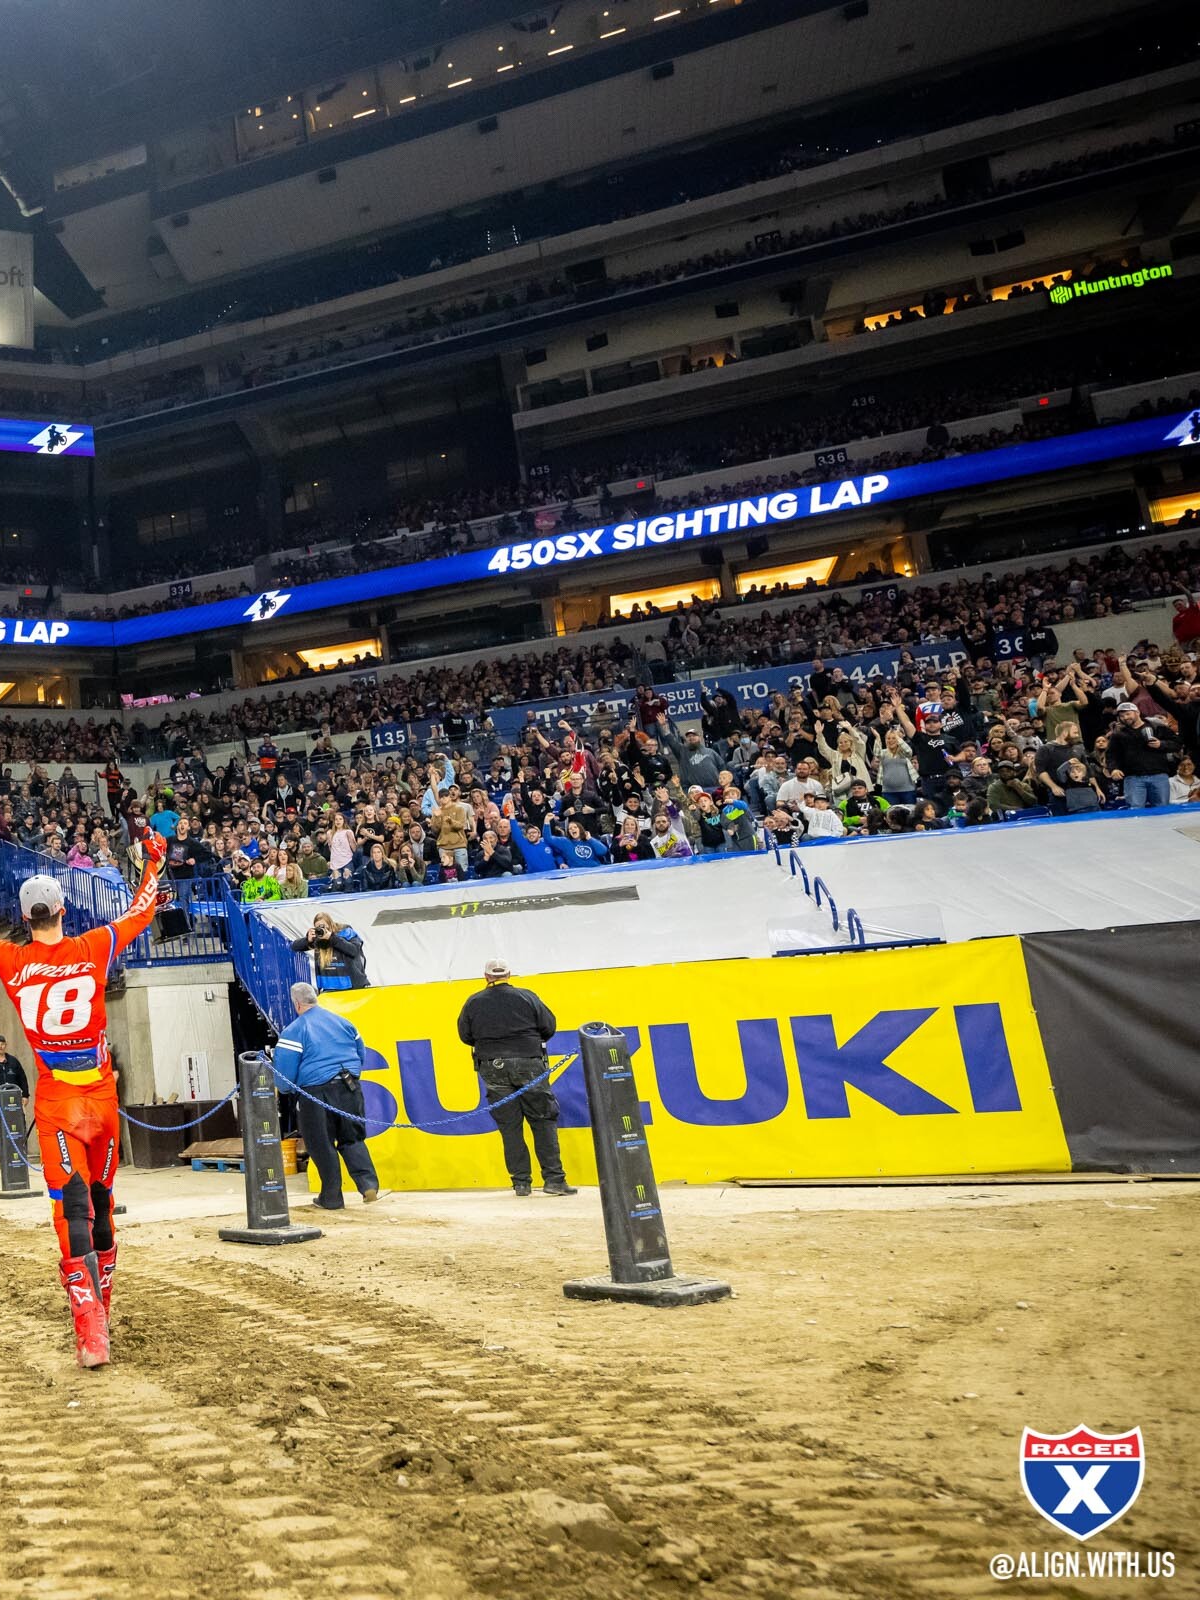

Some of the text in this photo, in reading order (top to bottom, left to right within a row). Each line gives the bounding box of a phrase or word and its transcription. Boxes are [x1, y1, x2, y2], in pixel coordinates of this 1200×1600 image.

[1073, 265, 1172, 298] Huntington
[487, 474, 889, 574] 450SX SIGHTING LAP
[170, 583, 191, 596] 334
[12, 620, 70, 645] LAP
[994, 636, 1023, 655] 36
[658, 688, 695, 702] SSUE
[738, 683, 769, 700] TO
[373, 729, 406, 748] 135
[8, 961, 97, 987] LAWRENCE
[15, 975, 97, 1036] 18
